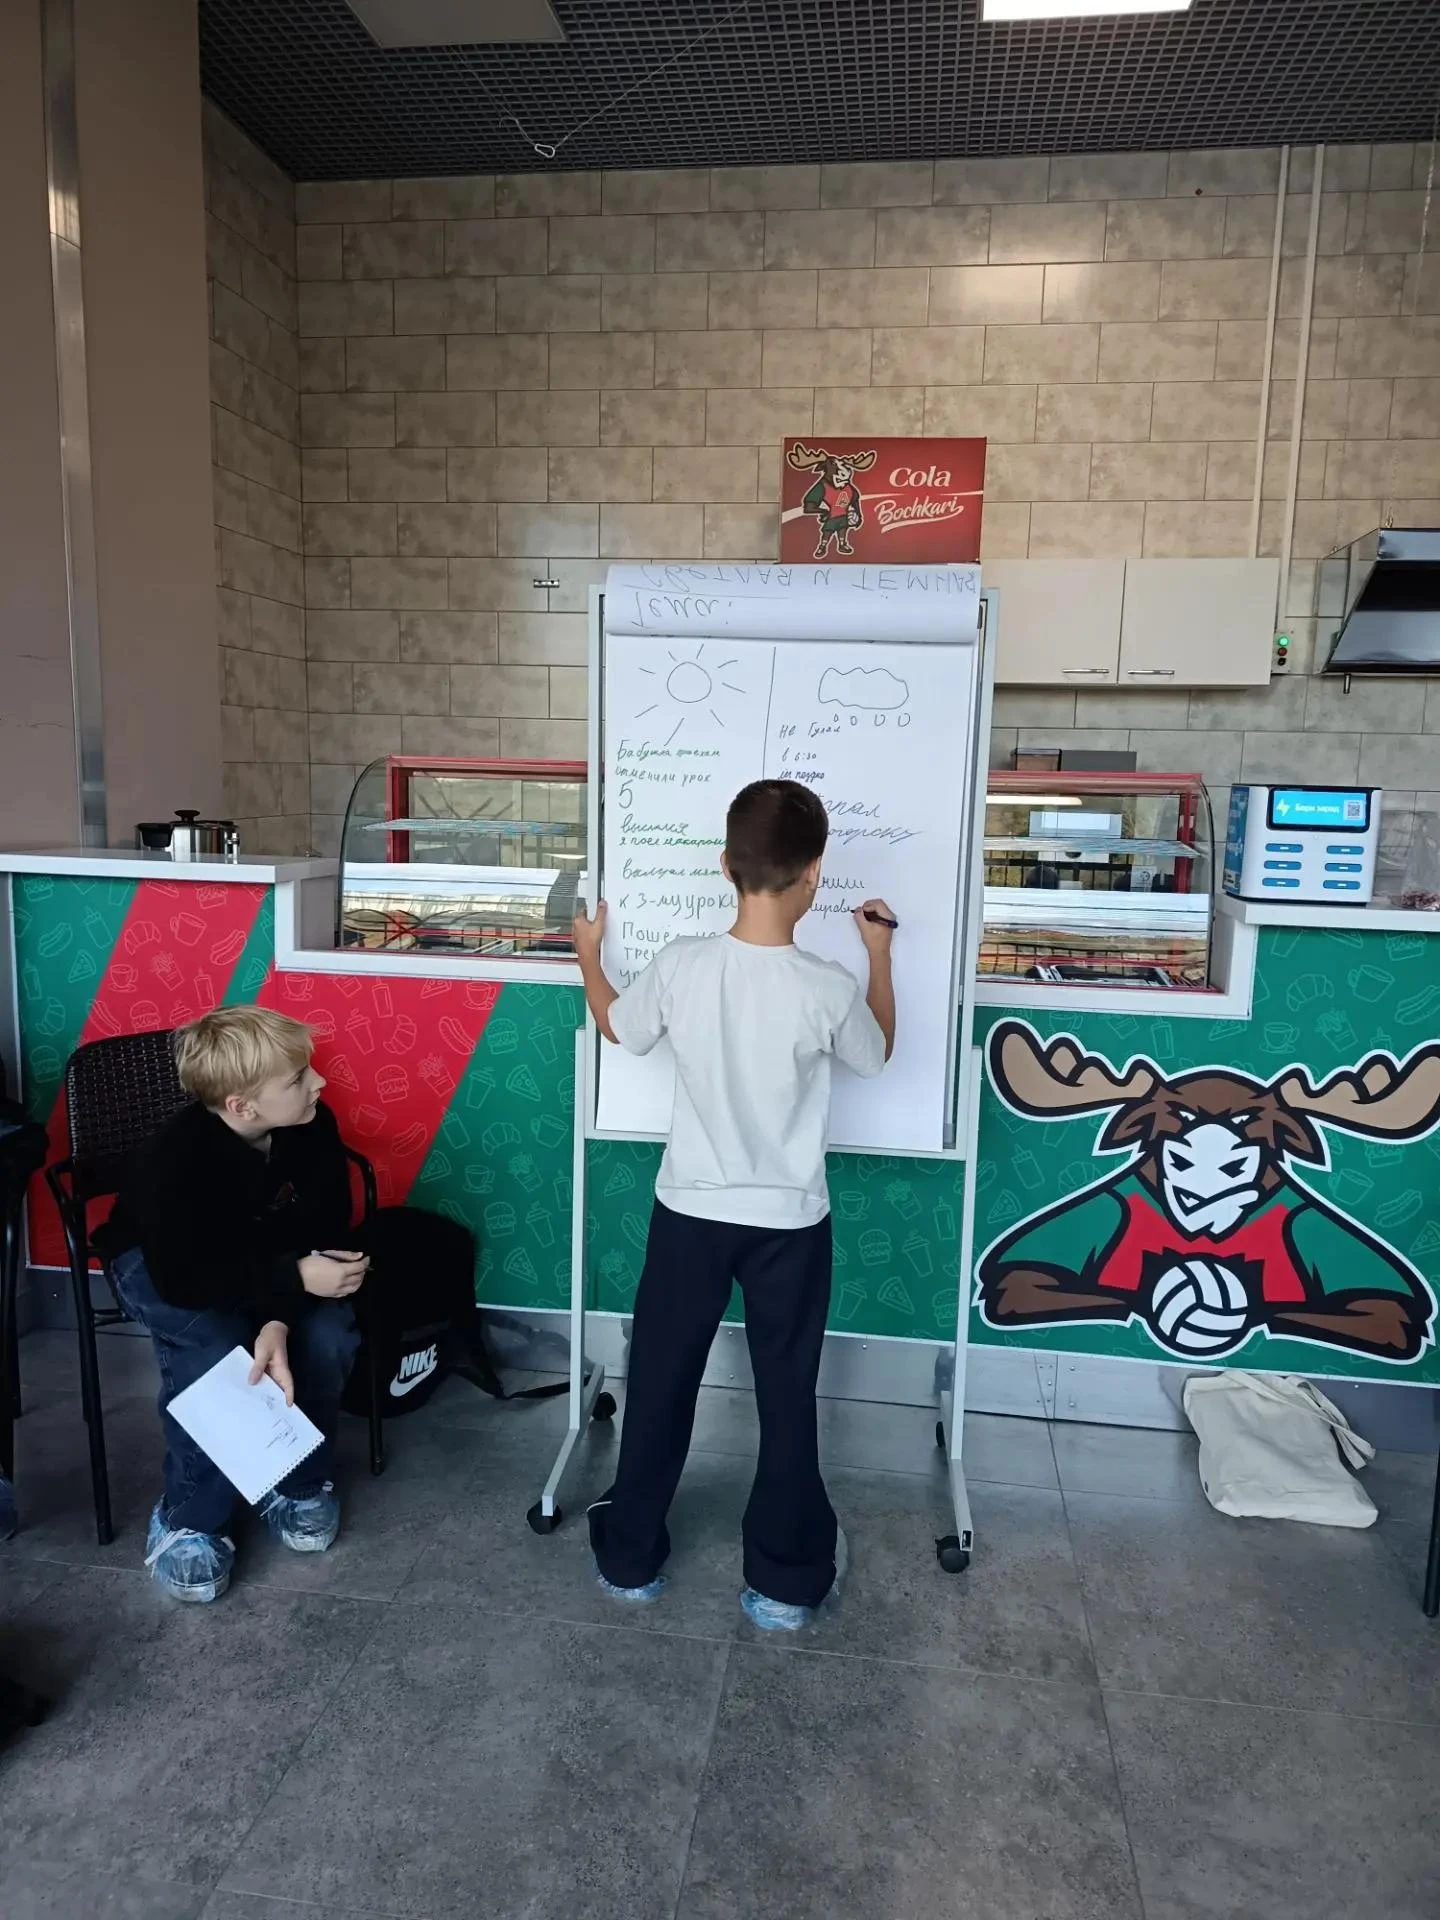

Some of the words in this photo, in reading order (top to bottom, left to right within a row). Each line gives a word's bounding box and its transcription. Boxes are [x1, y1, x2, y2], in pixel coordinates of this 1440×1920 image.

[889, 465, 951, 488] Cola
[874, 496, 964, 527] Bochkari
[618, 779, 633, 809] 5
[399, 1343, 438, 1380] NIKE
